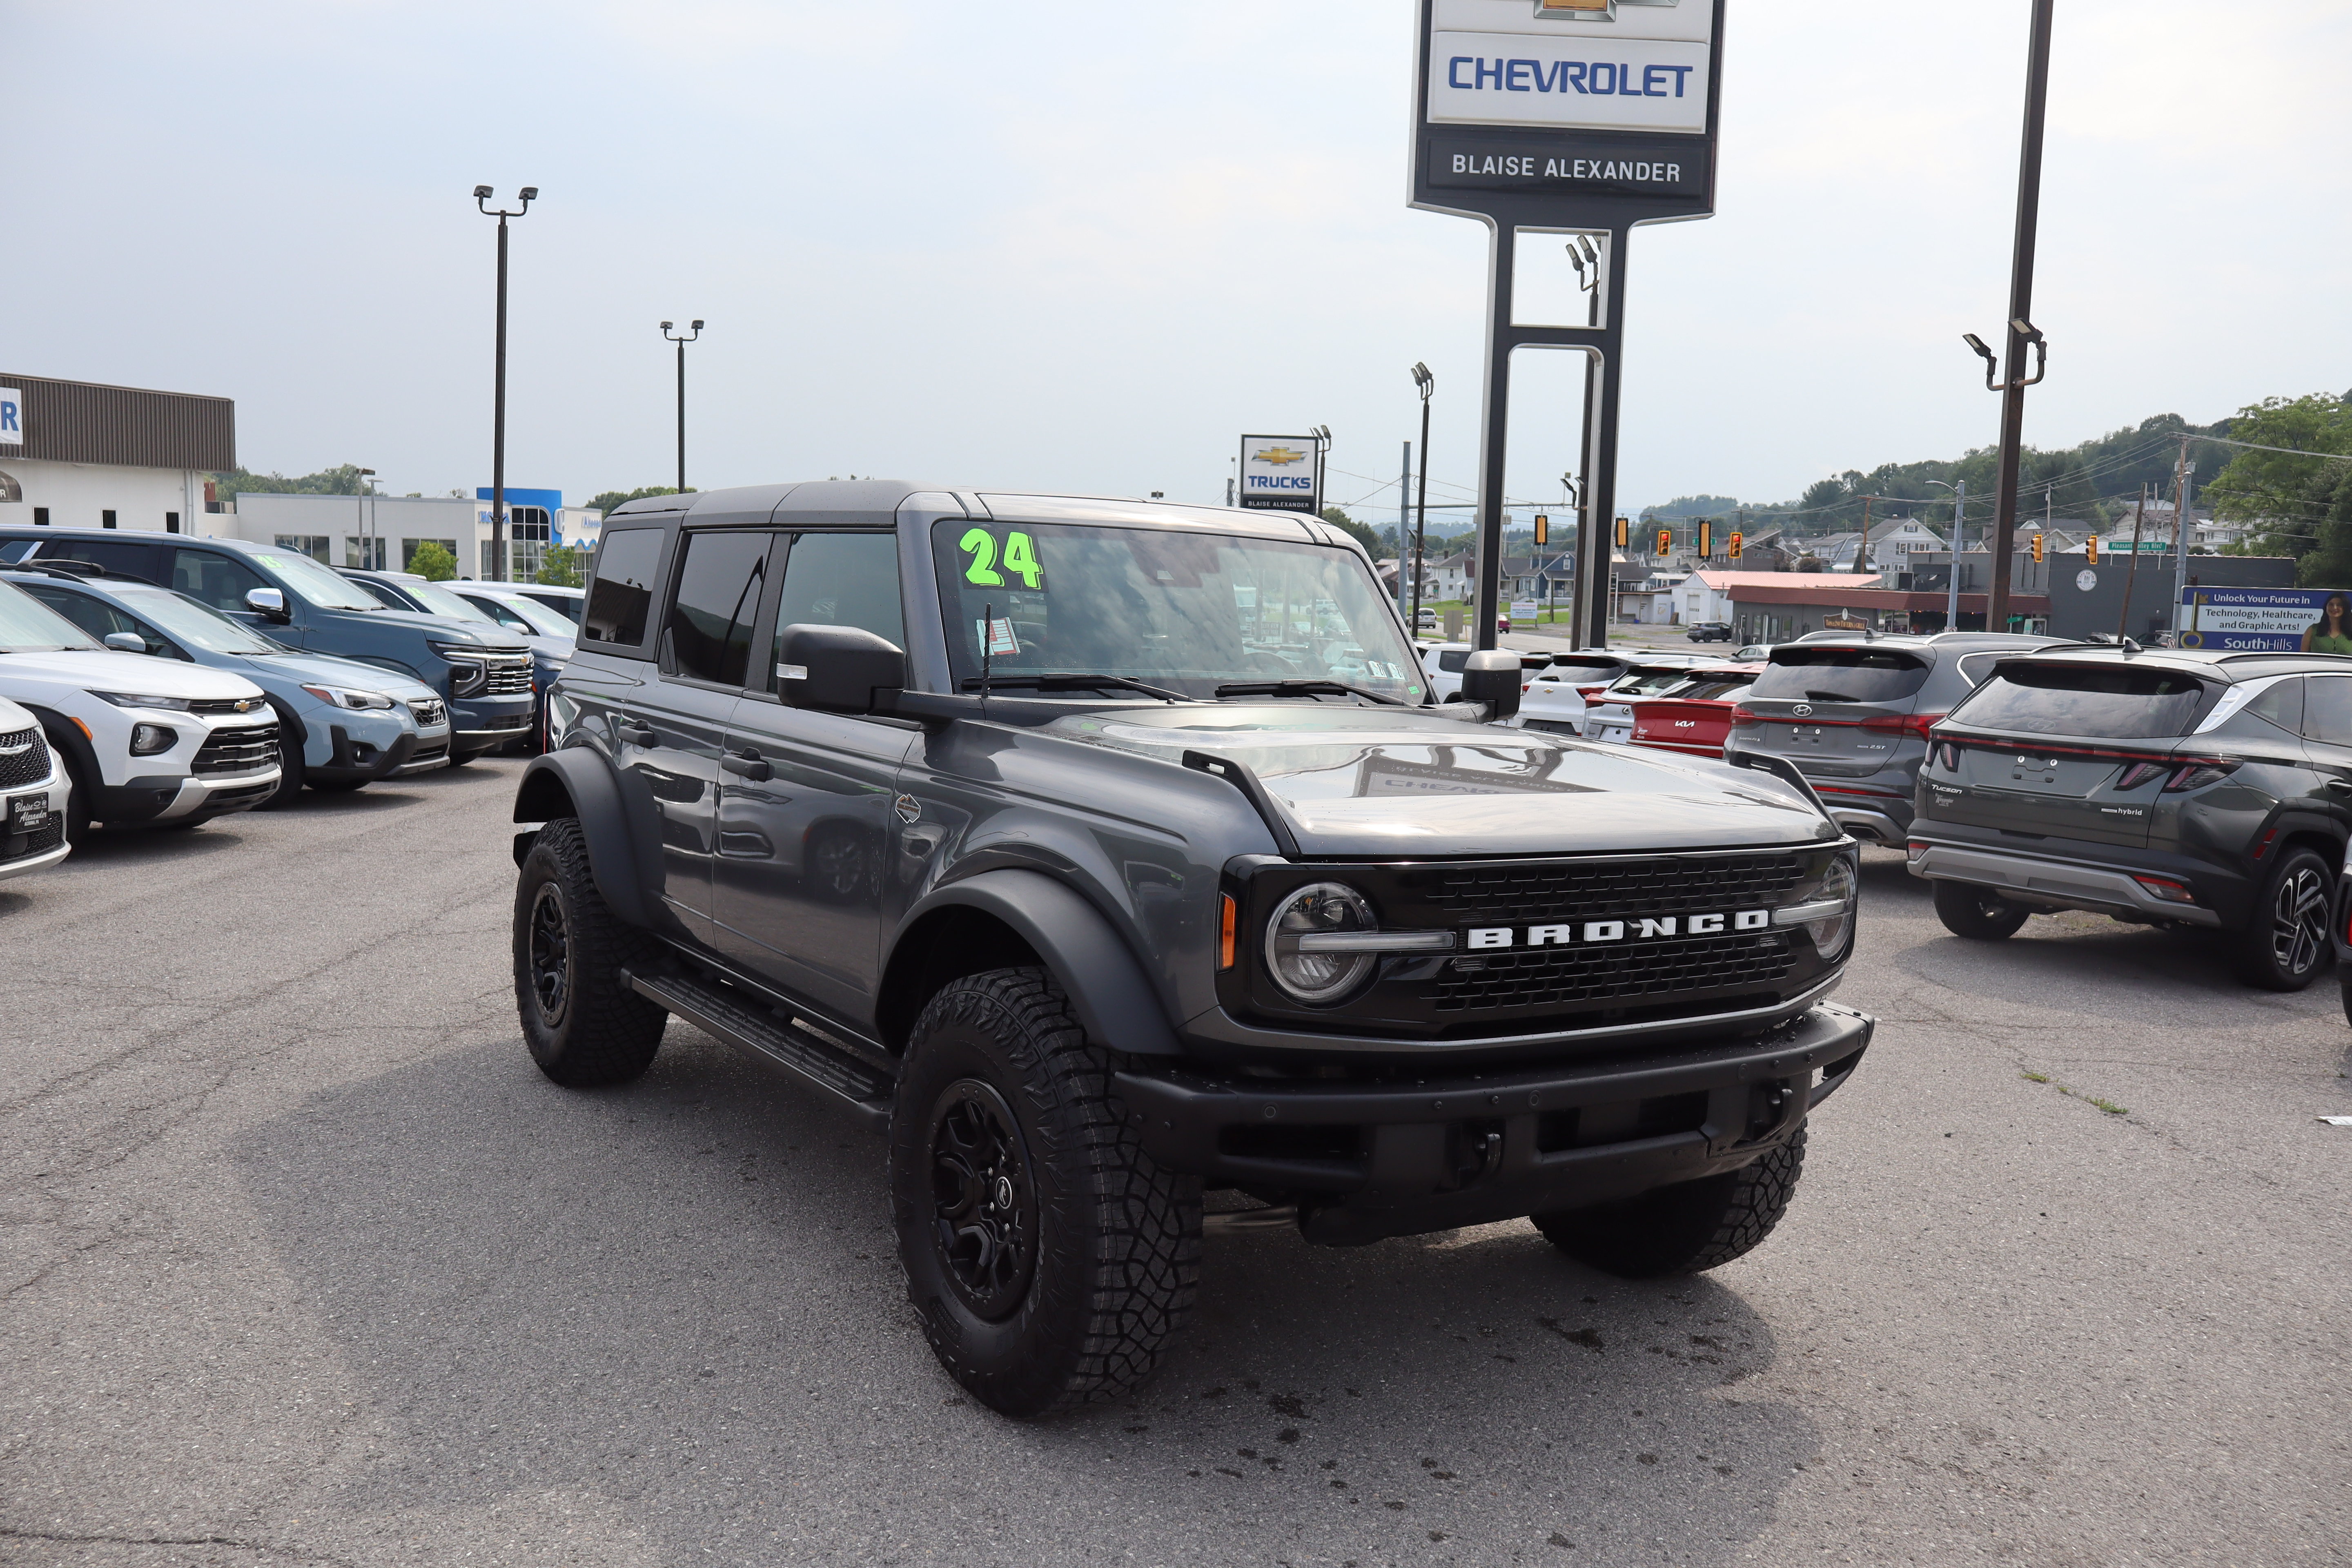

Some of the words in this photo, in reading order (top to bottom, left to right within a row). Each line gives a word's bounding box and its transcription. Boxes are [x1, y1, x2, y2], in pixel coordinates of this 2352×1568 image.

[1448, 56, 1693, 98] CHEVROLET
[1452, 154, 1535, 176] BLAISE
[1544, 158, 1680, 183] ALEXANDER
[1248, 475, 1311, 489] TRUCKS
[257, 555, 283, 568] 25
[959, 528, 1043, 590] 24
[2214, 594, 2245, 602] Unlock
[2247, 595, 2268, 603] Your
[2270, 595, 2300, 604] Future
[2301, 596, 2310, 604] in
[2205, 609, 2260, 619] Technology,
[2262, 610, 2316, 621] Healthcare,
[2219, 621, 2236, 629] and
[2238, 621, 2275, 631] Graphic
[2224, 638, 2292, 650] SouthHills
[15, 802, 33, 813] Blaise
[2118, 807, 2143, 816] hybrid
[19, 809, 47, 823] Alexander
[1468, 909, 1768, 949] BRONCO
